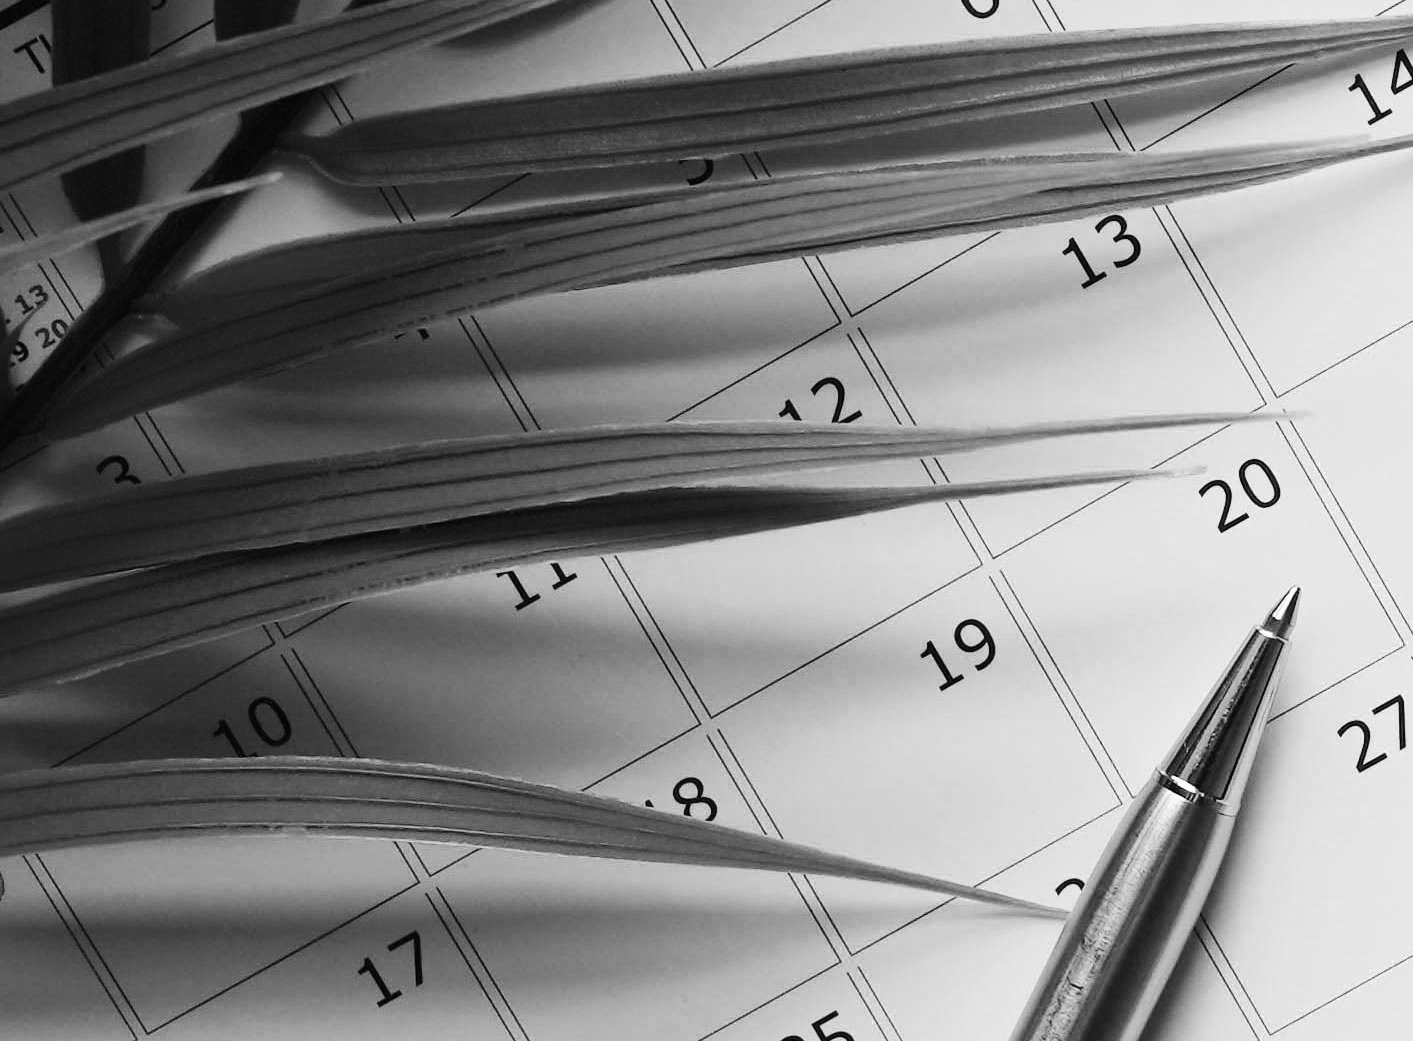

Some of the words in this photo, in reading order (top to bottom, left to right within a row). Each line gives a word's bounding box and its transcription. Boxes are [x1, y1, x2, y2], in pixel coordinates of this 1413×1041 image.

[1061, 213, 1143, 290] 13
[14, 284, 49, 315] 13
[35, 318, 69, 349] 20
[1198, 458, 1282, 534] 20
[919, 618, 997, 692] 19
[212, 696, 292, 758] 10
[1336, 694, 1408, 774] 27
[644, 776, 718, 822] 8
[357, 929, 425, 1008] 17
